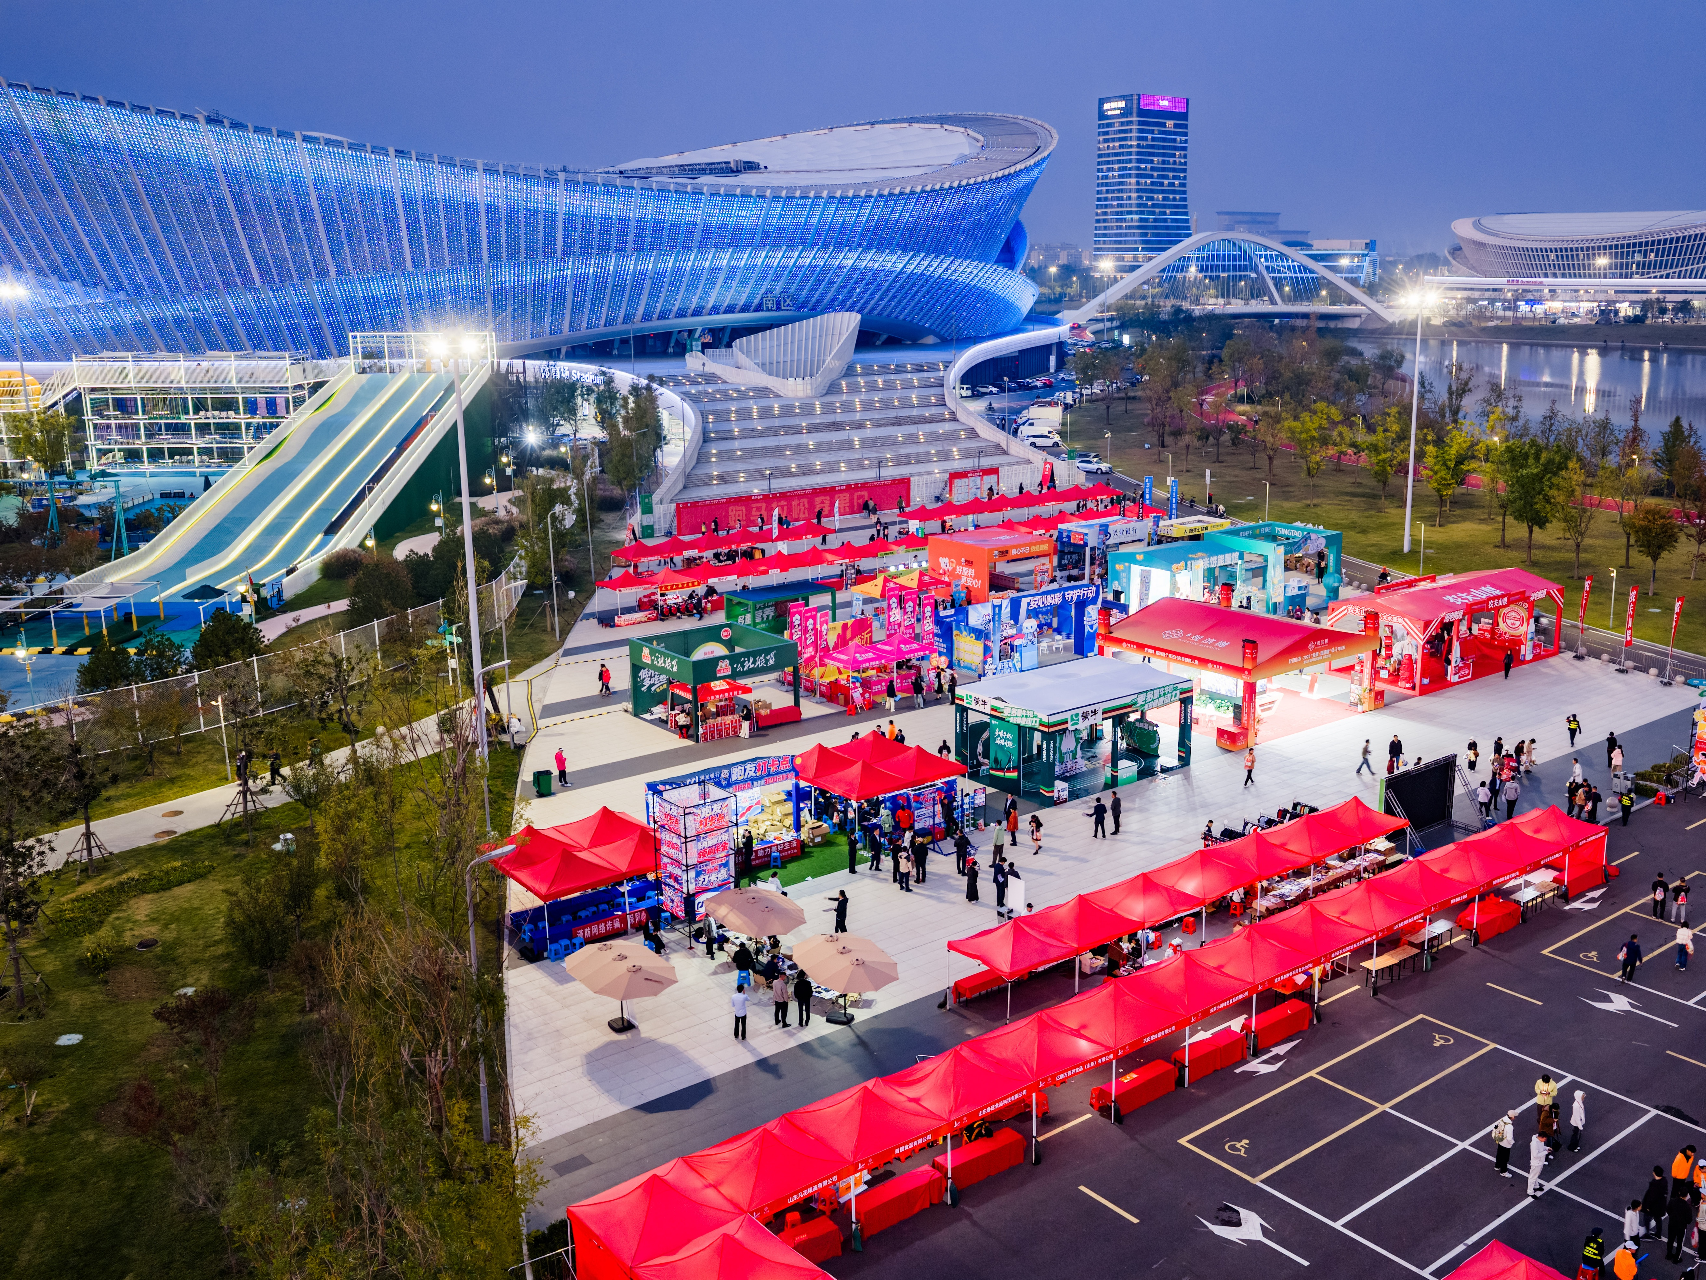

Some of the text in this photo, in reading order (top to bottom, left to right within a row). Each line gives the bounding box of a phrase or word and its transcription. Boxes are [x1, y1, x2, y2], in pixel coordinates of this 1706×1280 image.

[1275, 526, 1302, 538] TSINGTAO
[955, 565, 975, 578] 好原料
[1064, 585, 1096, 605] 守护行动
[973, 696, 988, 709] 蒙牛
[1081, 707, 1099, 723] 蒙牛
[730, 755, 792, 783] 跑友打卡点
[699, 813, 725, 829] 打卡点
